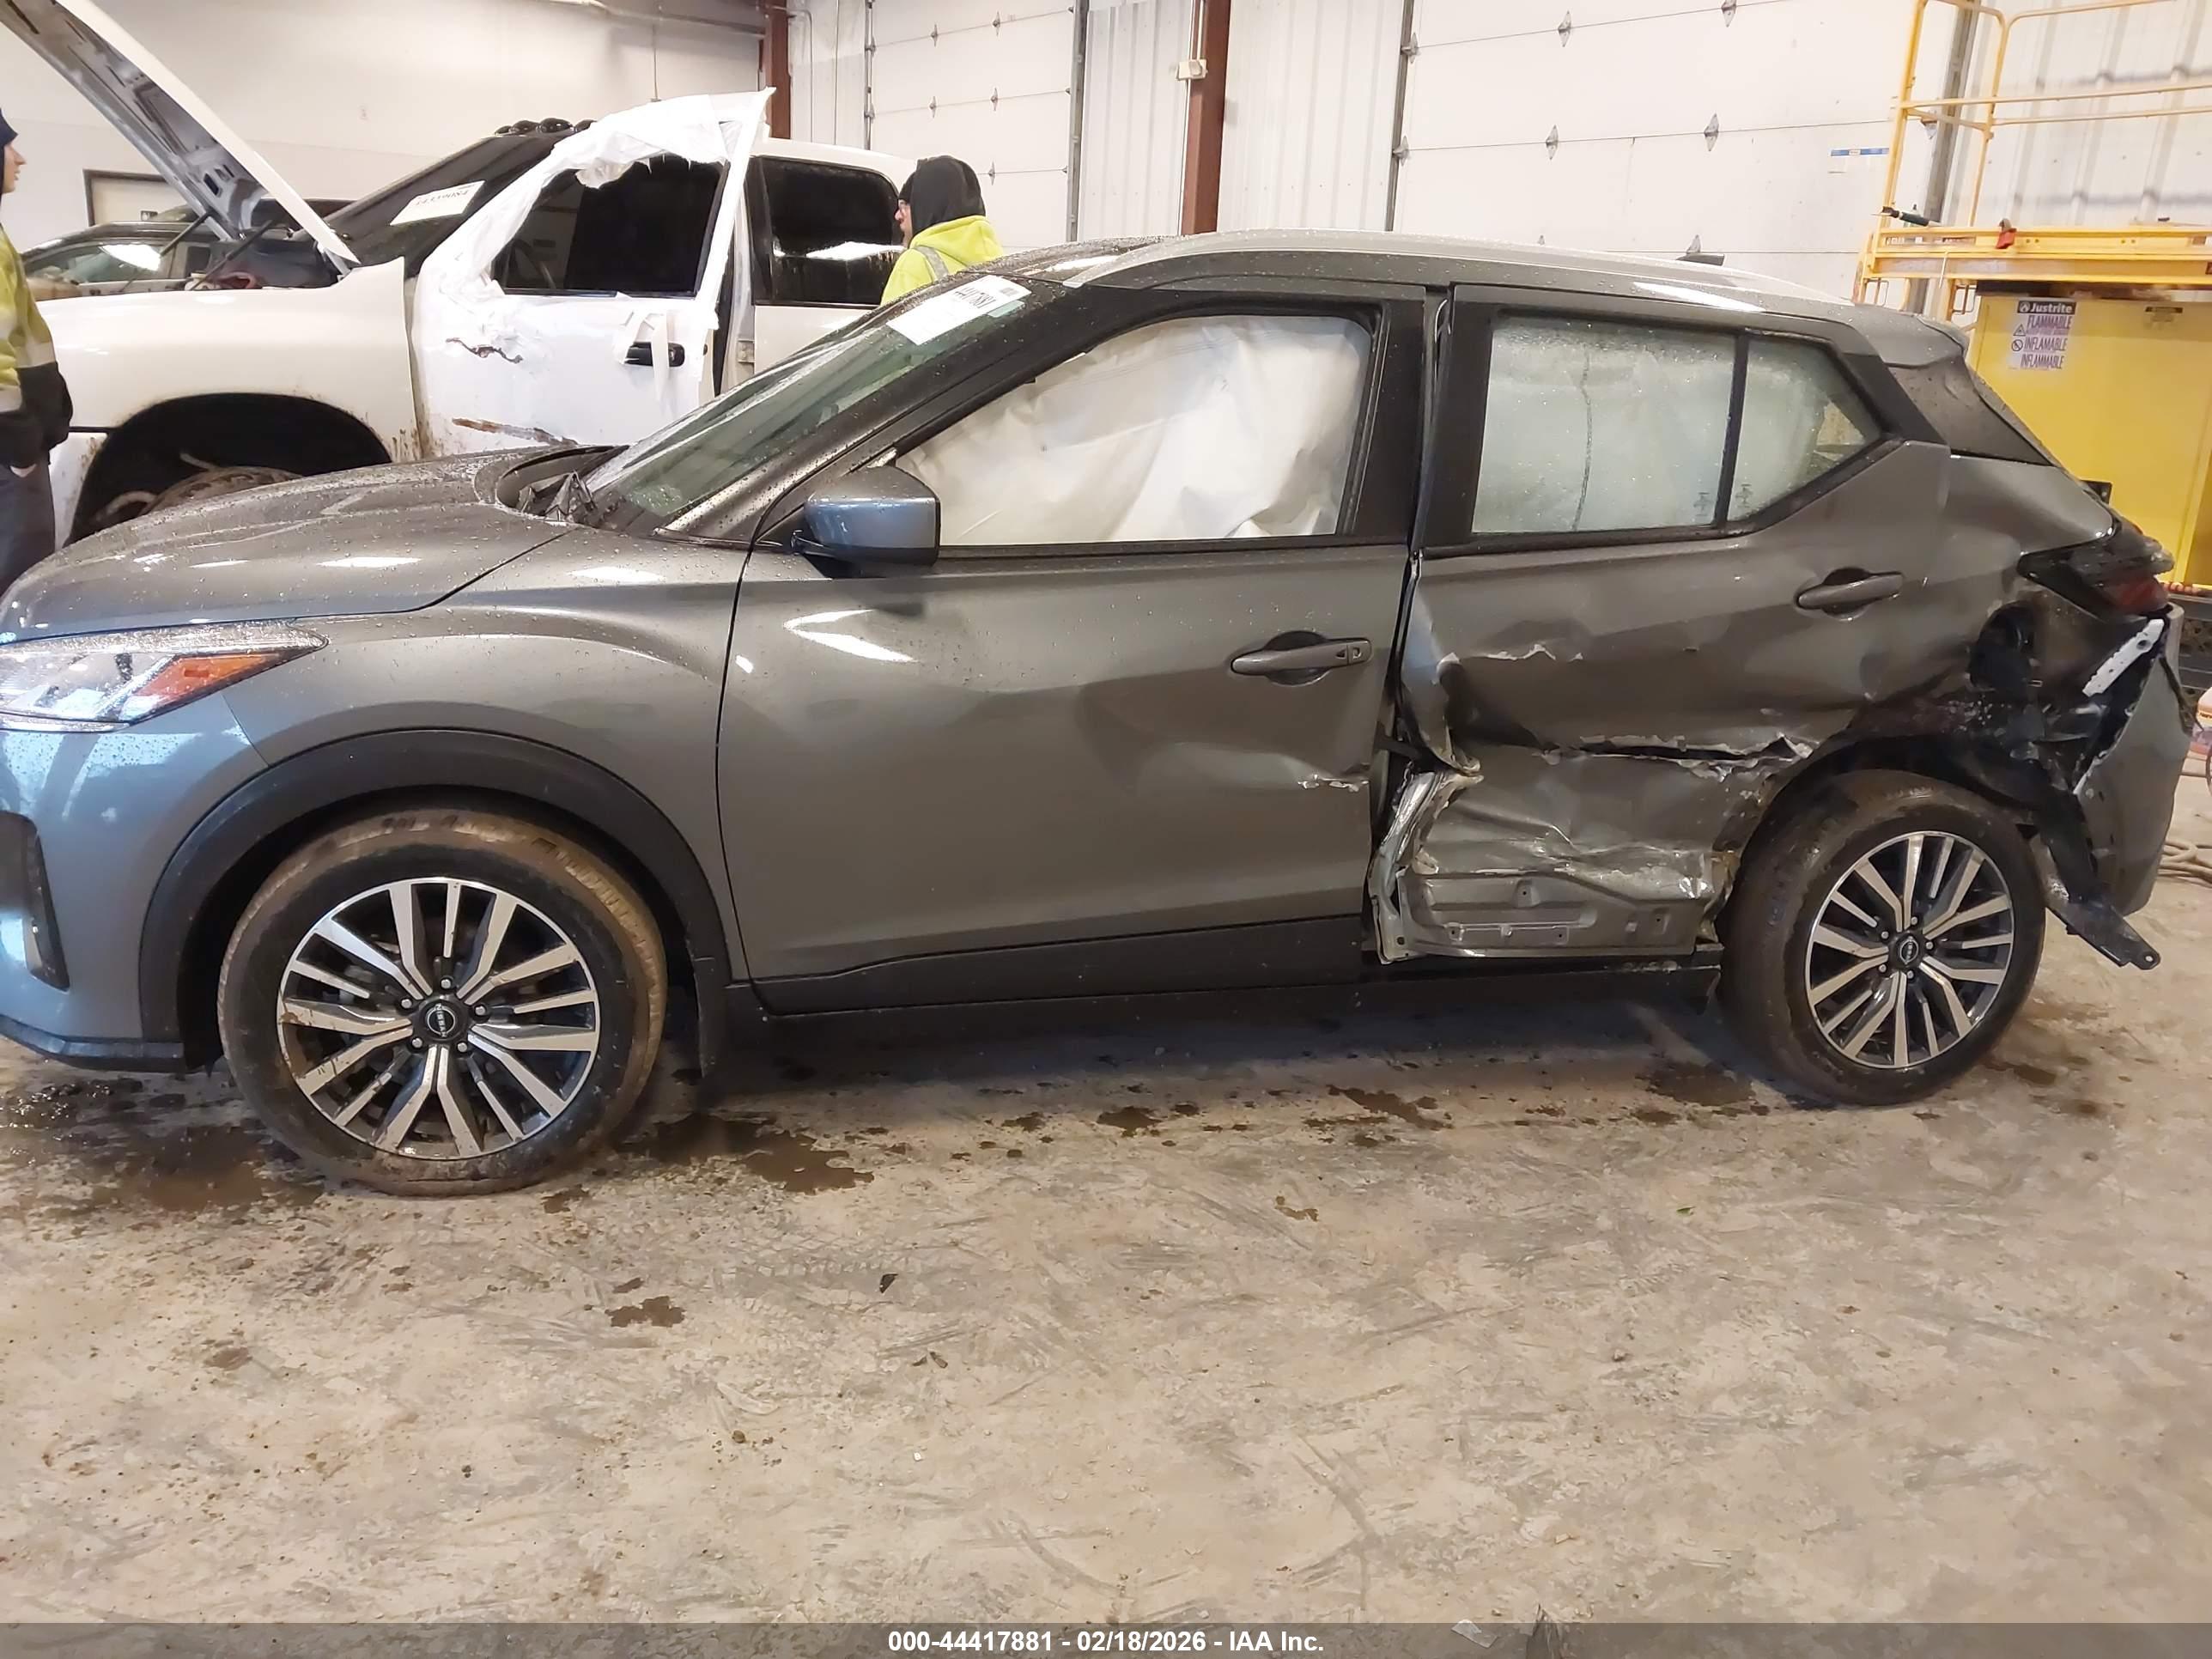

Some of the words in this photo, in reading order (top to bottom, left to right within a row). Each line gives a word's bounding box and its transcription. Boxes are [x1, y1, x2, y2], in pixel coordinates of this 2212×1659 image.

[2031, 302, 2073, 313] Justrite
[2027, 315, 2073, 329] FLAMMABLE
[2023, 336, 2068, 351] INFLAMABLE
[2020, 354, 2065, 369] INFLAMMABLE
